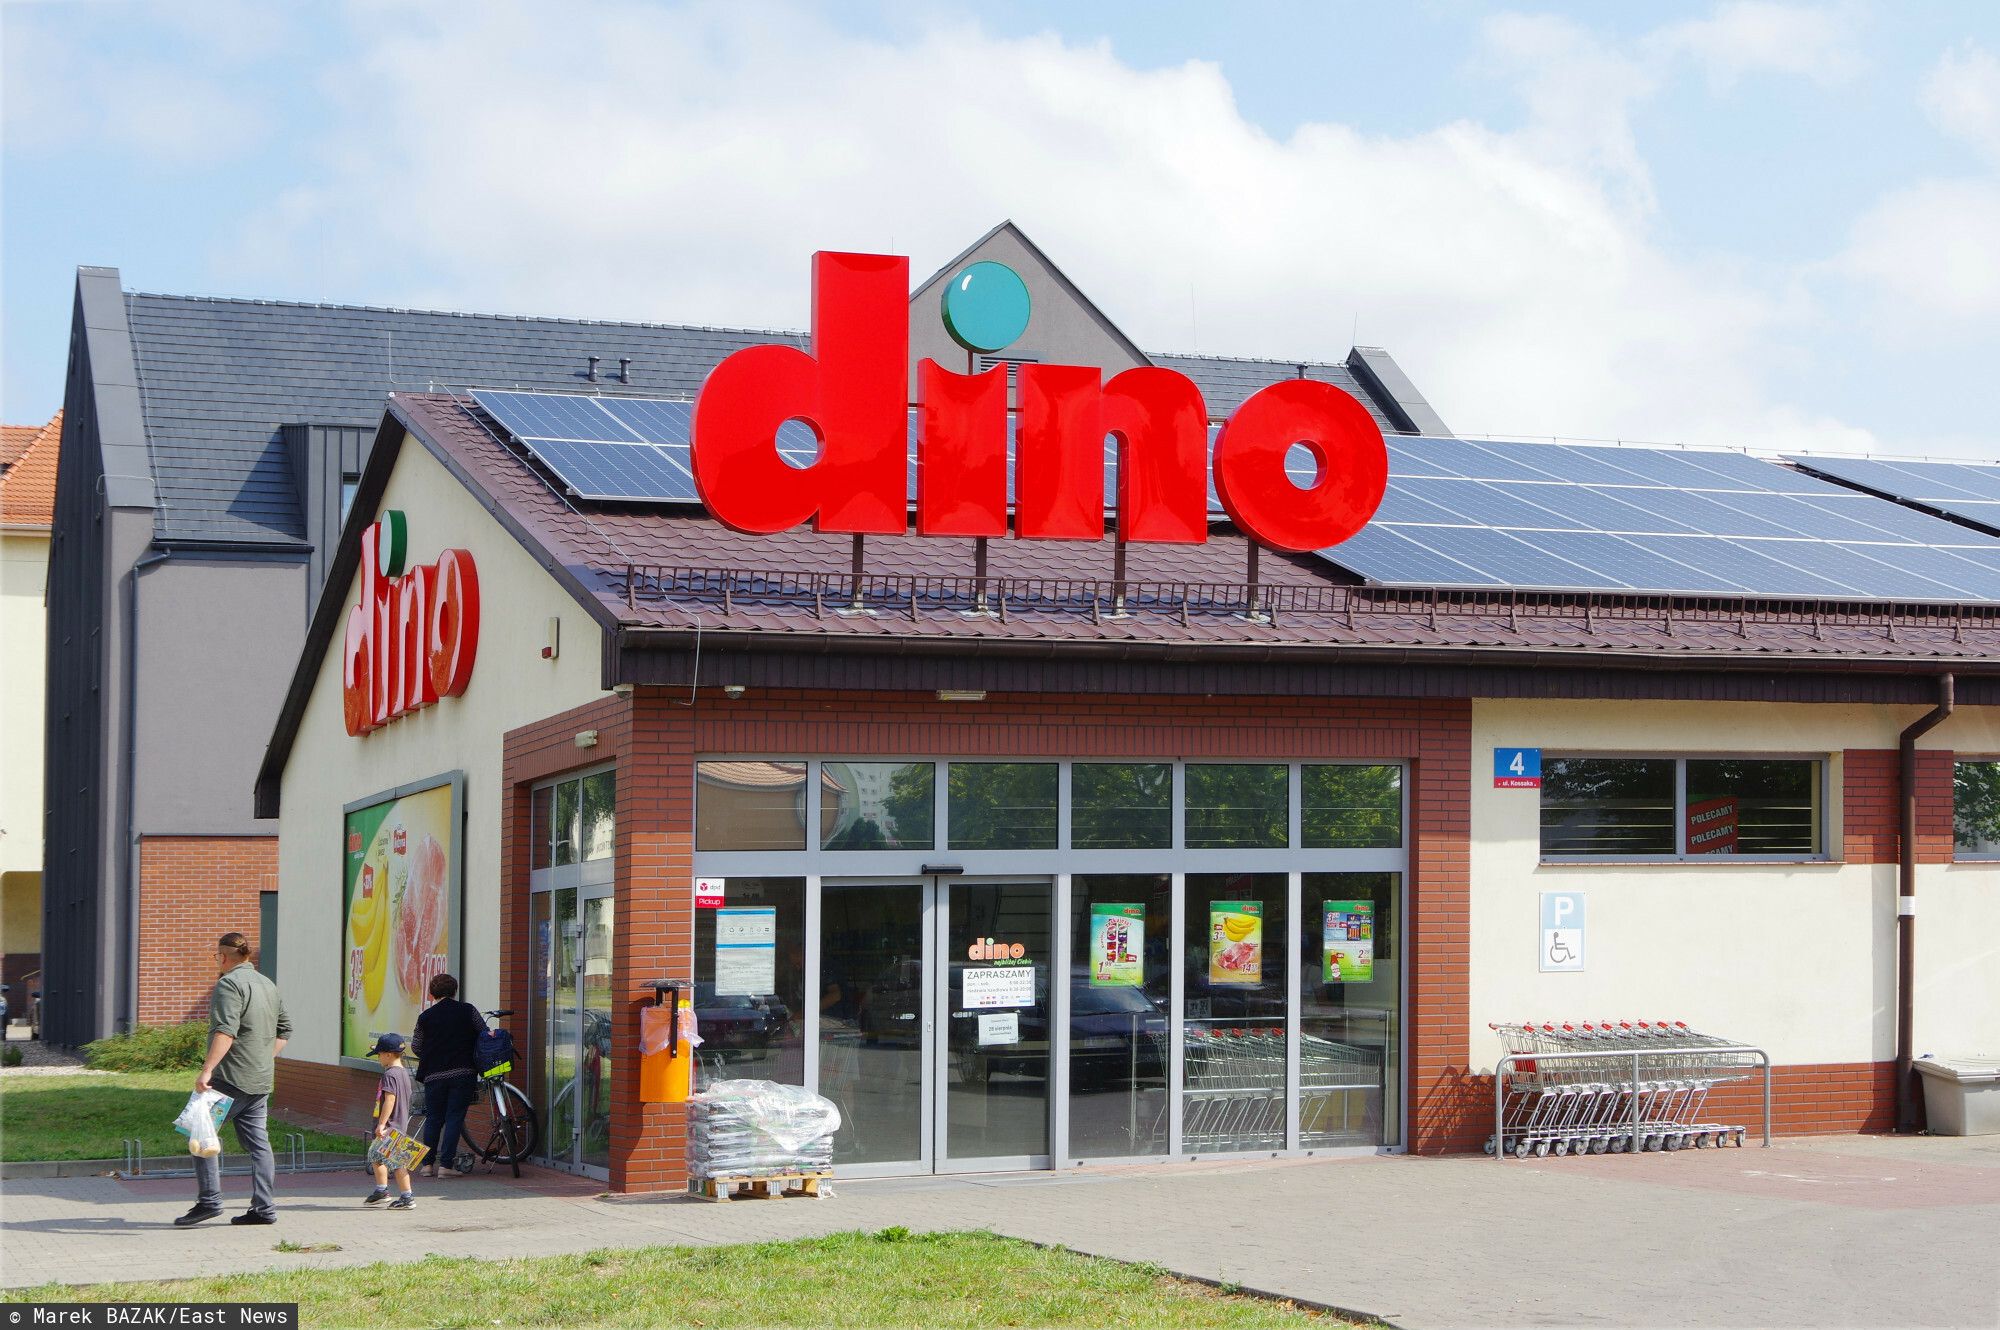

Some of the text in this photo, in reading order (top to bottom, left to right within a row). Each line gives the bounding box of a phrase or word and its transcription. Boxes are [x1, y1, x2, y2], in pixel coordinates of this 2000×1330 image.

[690, 251, 1388, 551] dino
[344, 510, 480, 737] dino
[1509, 752, 1525, 776] 4
[1690, 805, 1734, 825] POLECAMY
[1690, 825, 1734, 845] POLECAMY
[698, 898, 721, 906] Pickup
[1554, 896, 1574, 926] P
[968, 937, 1025, 960] dino
[967, 969, 1032, 980] ZAPRASZAMY
